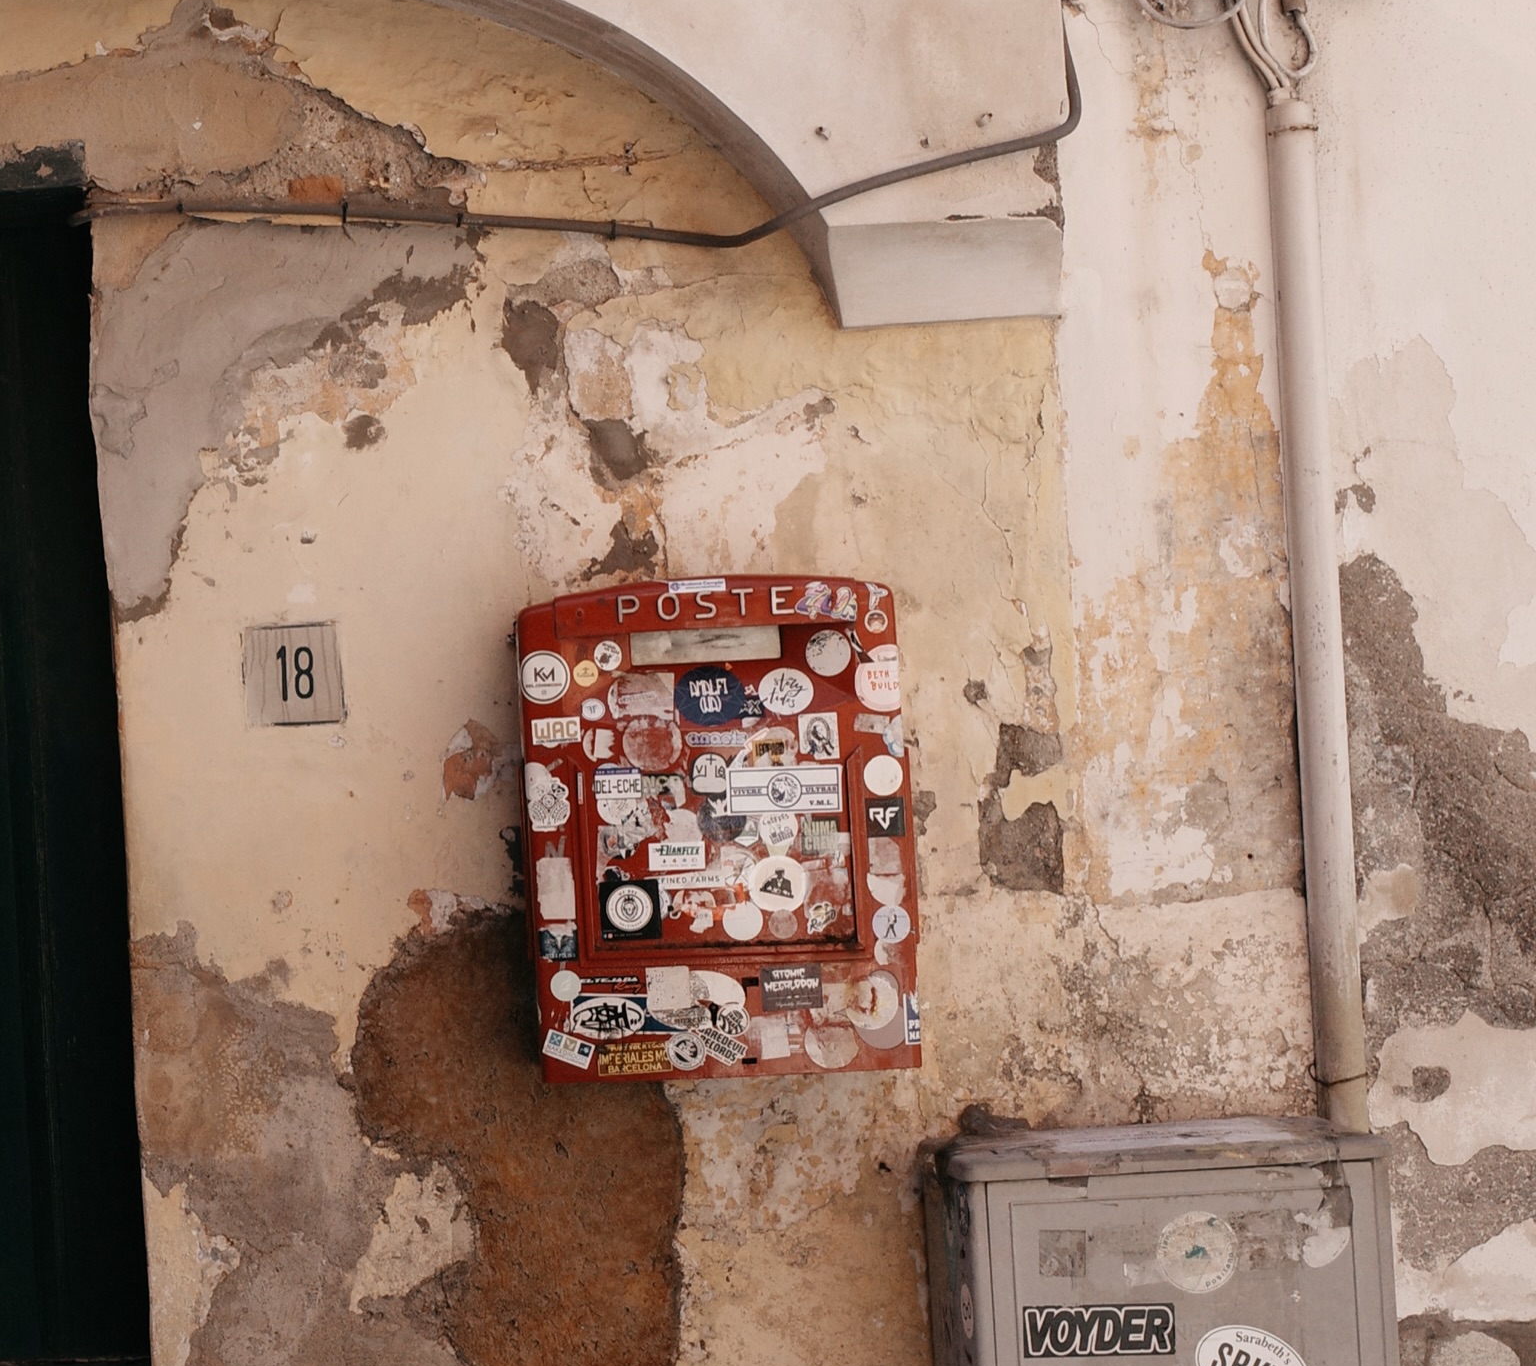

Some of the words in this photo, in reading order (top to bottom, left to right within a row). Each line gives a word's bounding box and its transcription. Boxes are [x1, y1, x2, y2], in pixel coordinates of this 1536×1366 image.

[617, 585, 795, 624] POSTE
[276, 645, 314, 702] 18
[533, 720, 579, 740] WAC
[805, 786, 838, 794] ULTRAS
[690, 875, 721, 884] FARMS
[771, 968, 806, 979] ATOMIC
[607, 1062, 663, 1074] BARCELONA
[1025, 1306, 1173, 1356] VOYDER
